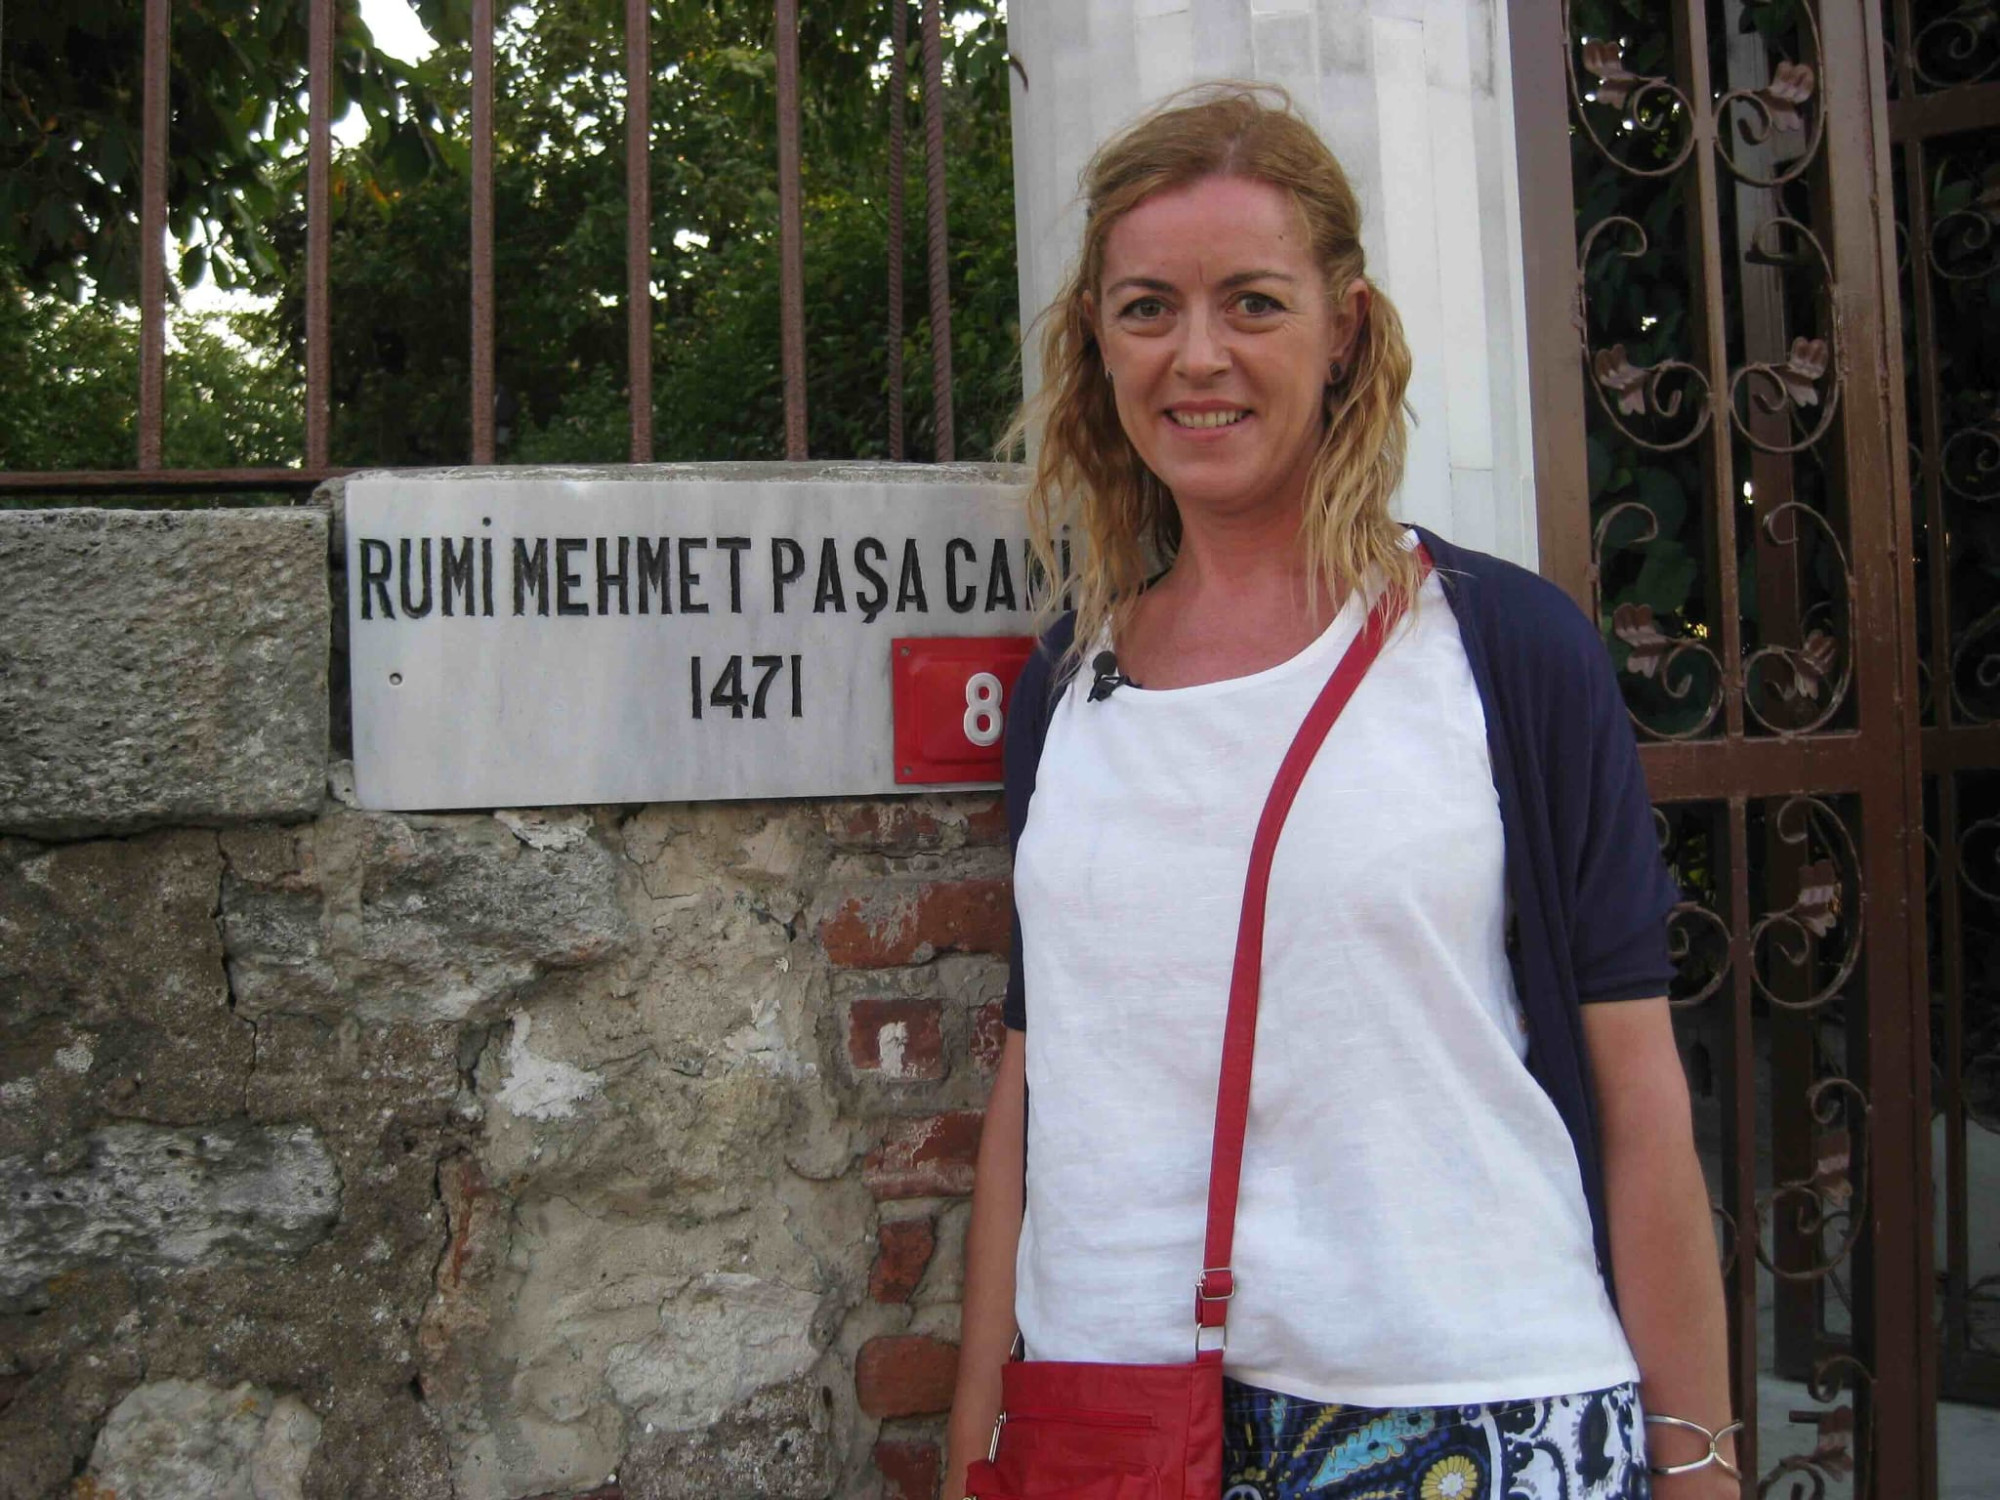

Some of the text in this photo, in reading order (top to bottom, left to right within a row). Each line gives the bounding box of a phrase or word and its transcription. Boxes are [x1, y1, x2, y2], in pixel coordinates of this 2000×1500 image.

[512, 536, 751, 616] MEHMET
[771, 536, 928, 624] PAŞA
[691, 655, 803, 719] 1471
[963, 672, 1003, 747] 8
